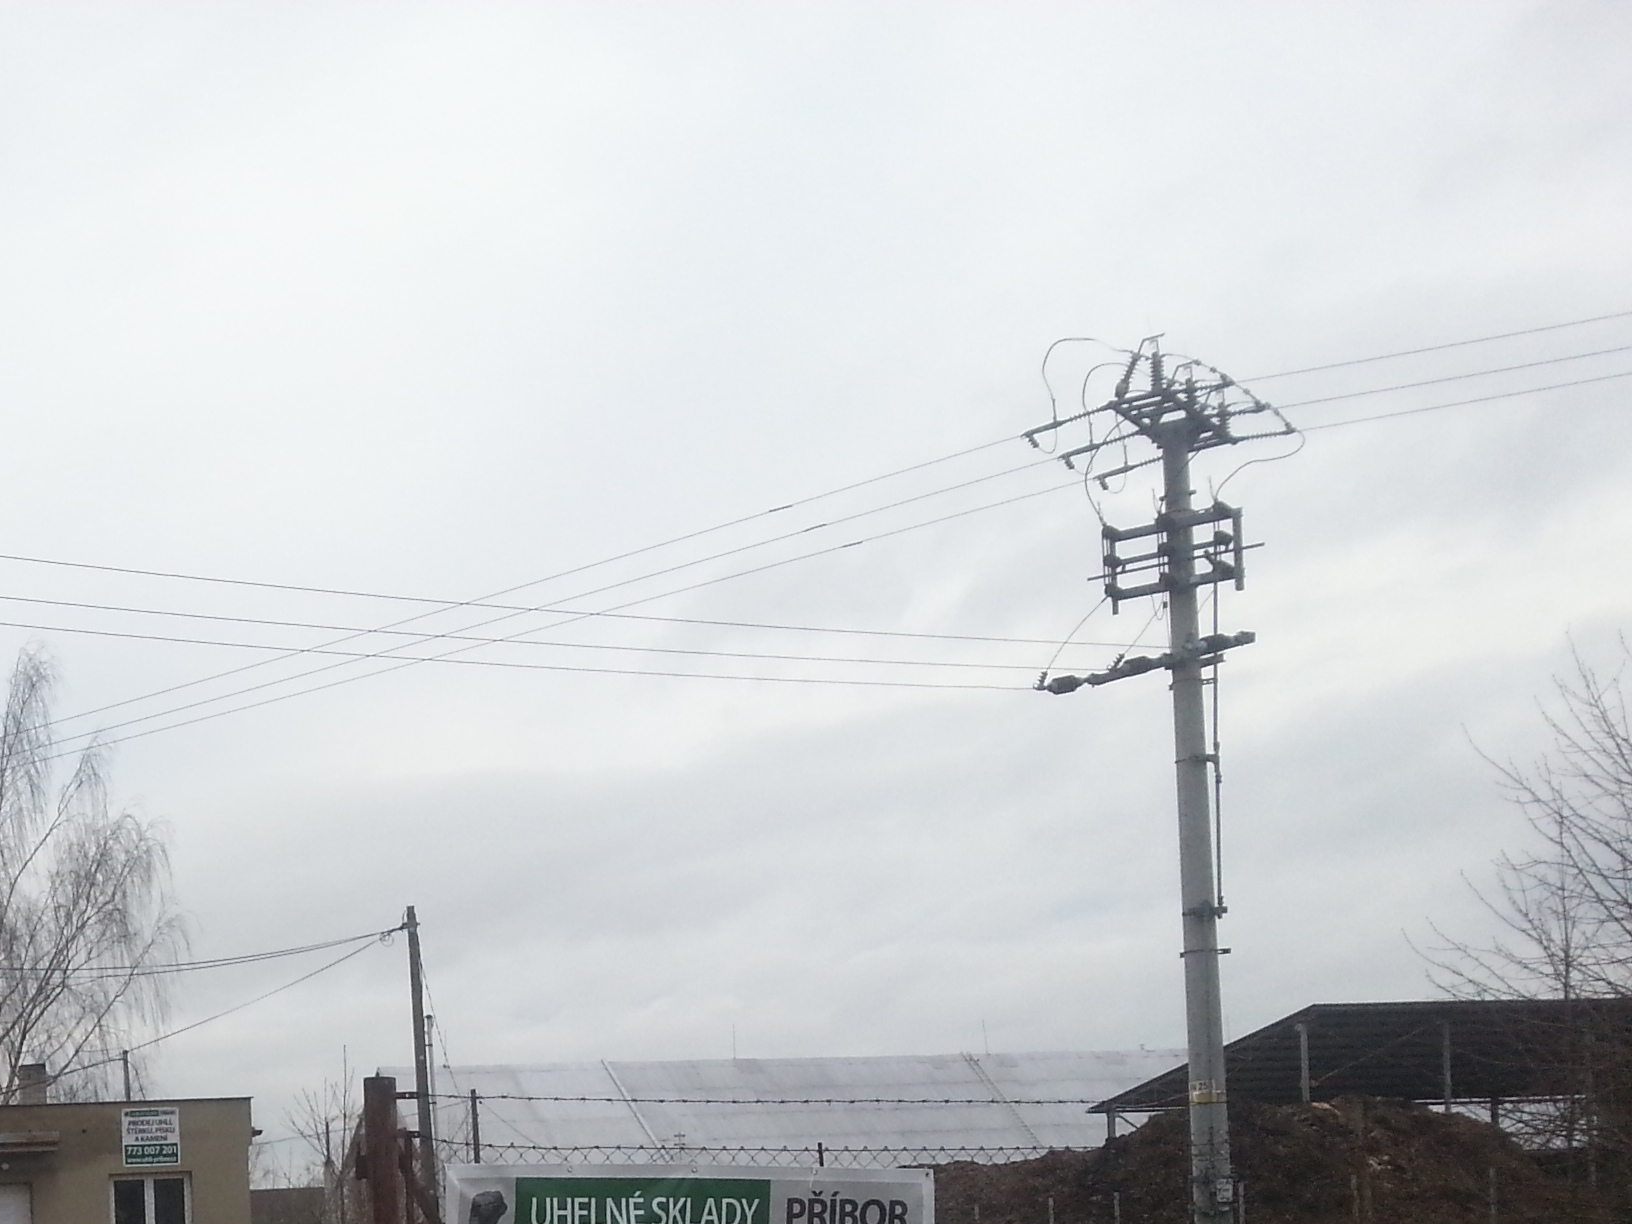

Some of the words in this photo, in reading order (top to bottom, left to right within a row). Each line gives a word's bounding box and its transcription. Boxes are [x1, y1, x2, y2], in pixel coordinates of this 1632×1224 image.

[126, 1146, 142, 1155] 773
[144, 1146, 160, 1154] 007
[162, 1145, 177, 1154] 201
